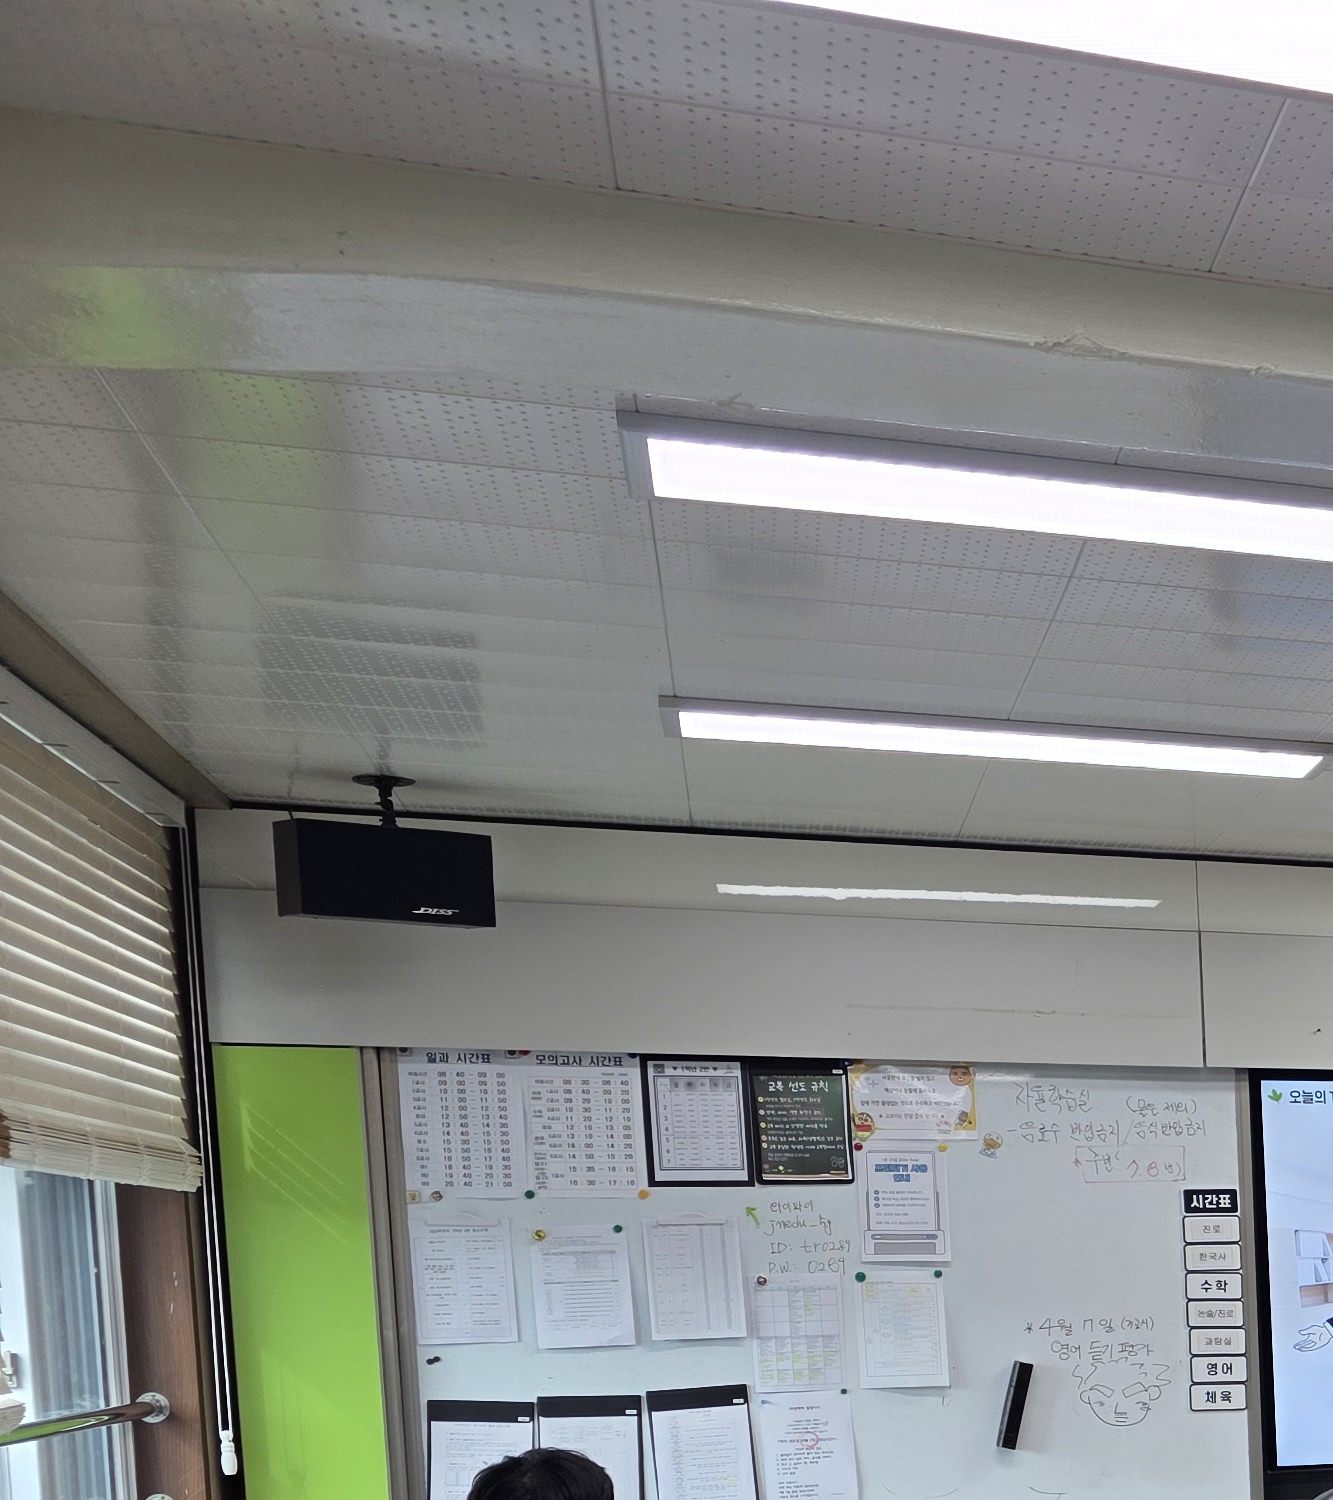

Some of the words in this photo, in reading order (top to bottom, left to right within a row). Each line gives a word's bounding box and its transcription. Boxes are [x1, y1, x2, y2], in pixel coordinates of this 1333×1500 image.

[426, 1052, 449, 1064] 일과
[456, 1052, 492, 1064] 시간표
[535, 1054, 582, 1067] 모의고사
[589, 1055, 623, 1067] 시간표
[768, 1081, 784, 1092] 교복
[788, 1082, 807, 1092] 선도
[811, 1080, 829, 1092] 규칙
[1289, 1089, 1326, 1105] 오늘의
[770, 1200, 814, 1214] 와이파이
[1190, 1194, 1232, 1209] 시간표
[1202, 1225, 1221, 1234] 진로
[1199, 1252, 1227, 1262] 한국사
[1200, 1279, 1229, 1293] 수학
[1197, 1309, 1235, 1318] 논술/진로
[1051, 1340, 1081, 1361] 영어
[1087, 1341, 1113, 1361] 듣기
[1118, 1342, 1155, 1357] 평가
[1206, 1362, 1233, 1376] 영어
[1205, 1390, 1233, 1404] 체육
